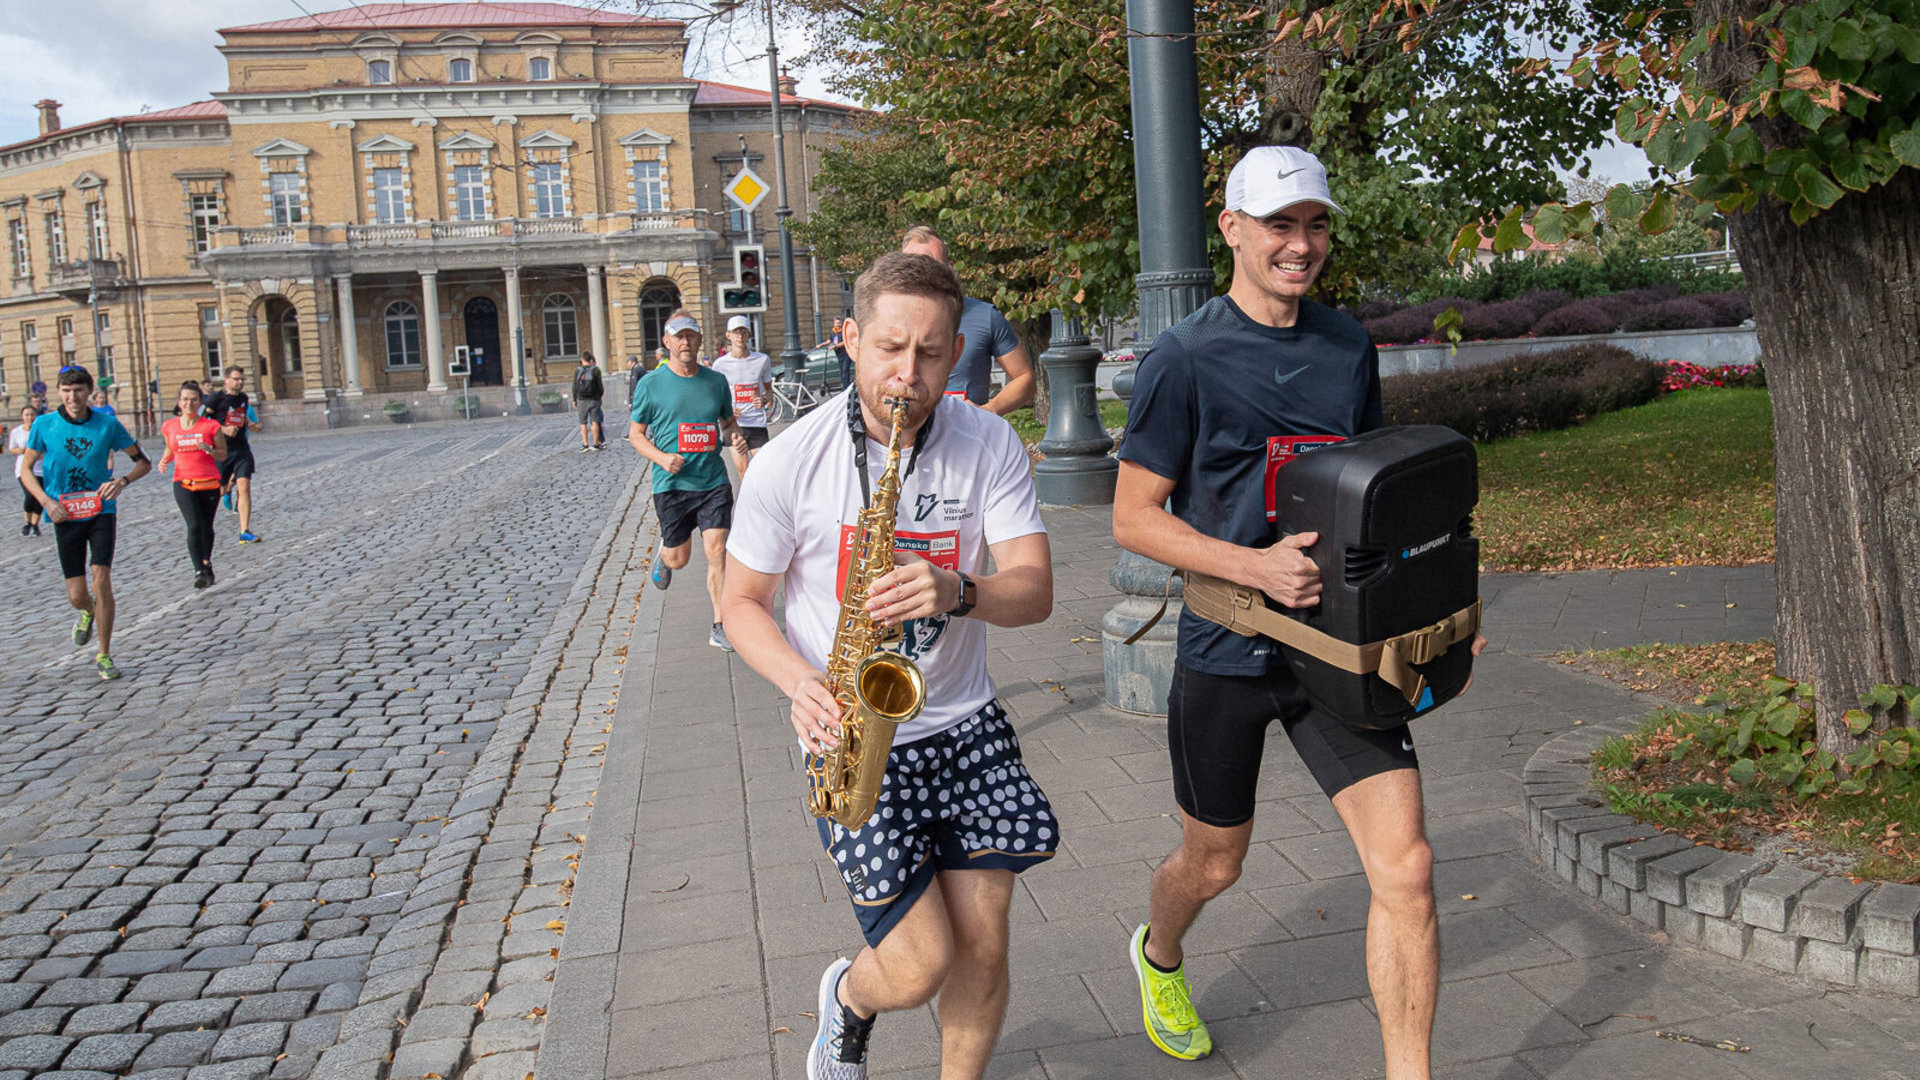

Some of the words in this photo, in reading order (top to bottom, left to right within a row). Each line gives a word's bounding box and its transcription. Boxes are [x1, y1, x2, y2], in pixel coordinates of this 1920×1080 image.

[67, 500, 95, 512] 2146
[894, 540, 928, 549] Danske
[932, 541, 954, 549] Bank
[1409, 533, 1451, 557] BLAUPUNKT
